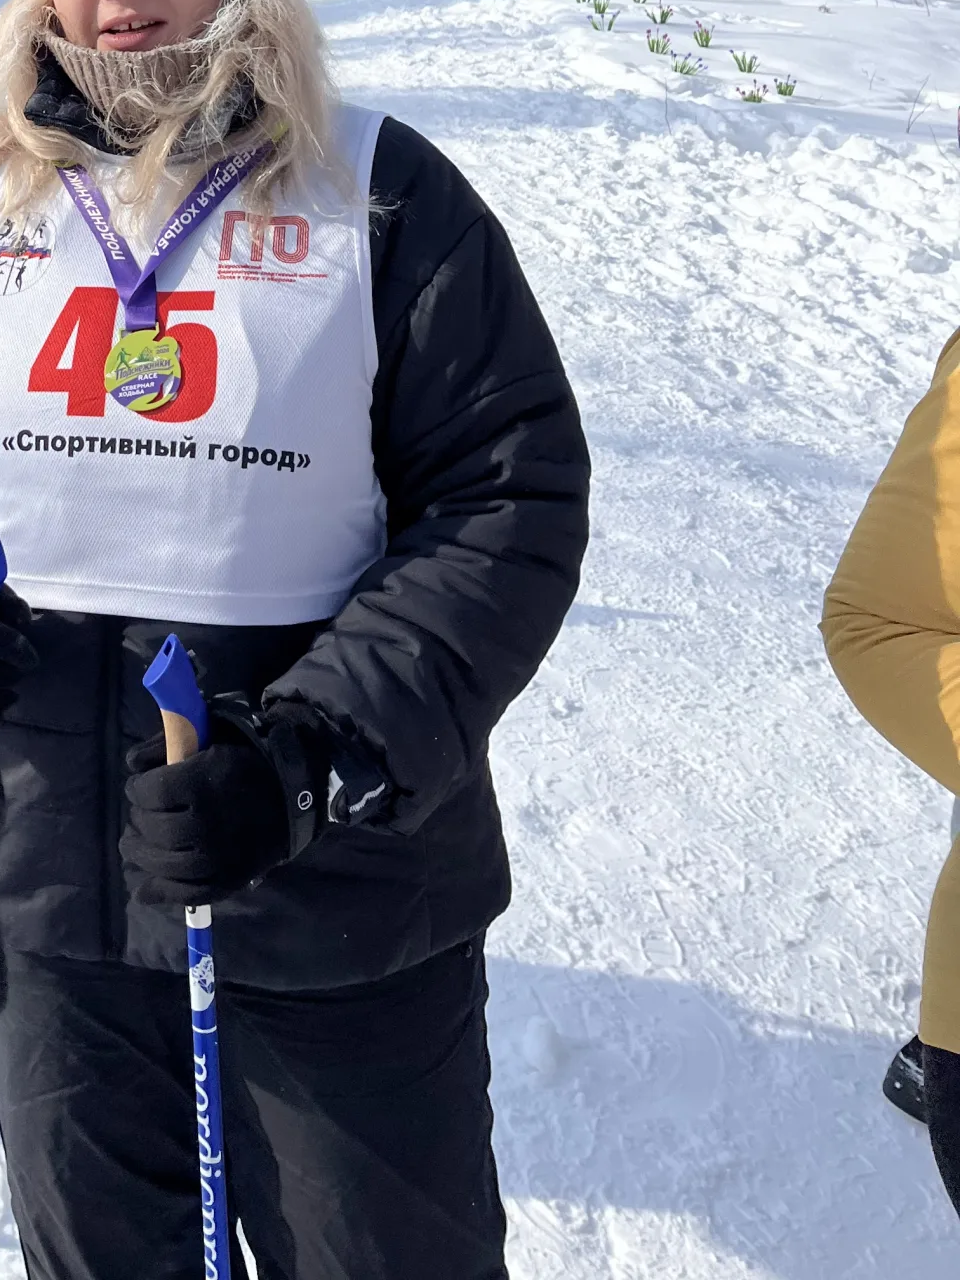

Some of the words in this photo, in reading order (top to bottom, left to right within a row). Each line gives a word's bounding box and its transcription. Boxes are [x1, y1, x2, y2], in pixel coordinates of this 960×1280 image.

[62, 168, 126, 261] ПОДСНЕЖНИКИ
[149, 202, 201, 257] ХОДЬБА
[27, 286, 219, 424] 45
[137, 372, 158, 381] RACE
[2, 428, 197, 460] «Спортивный
[207, 440, 312, 473] город»
